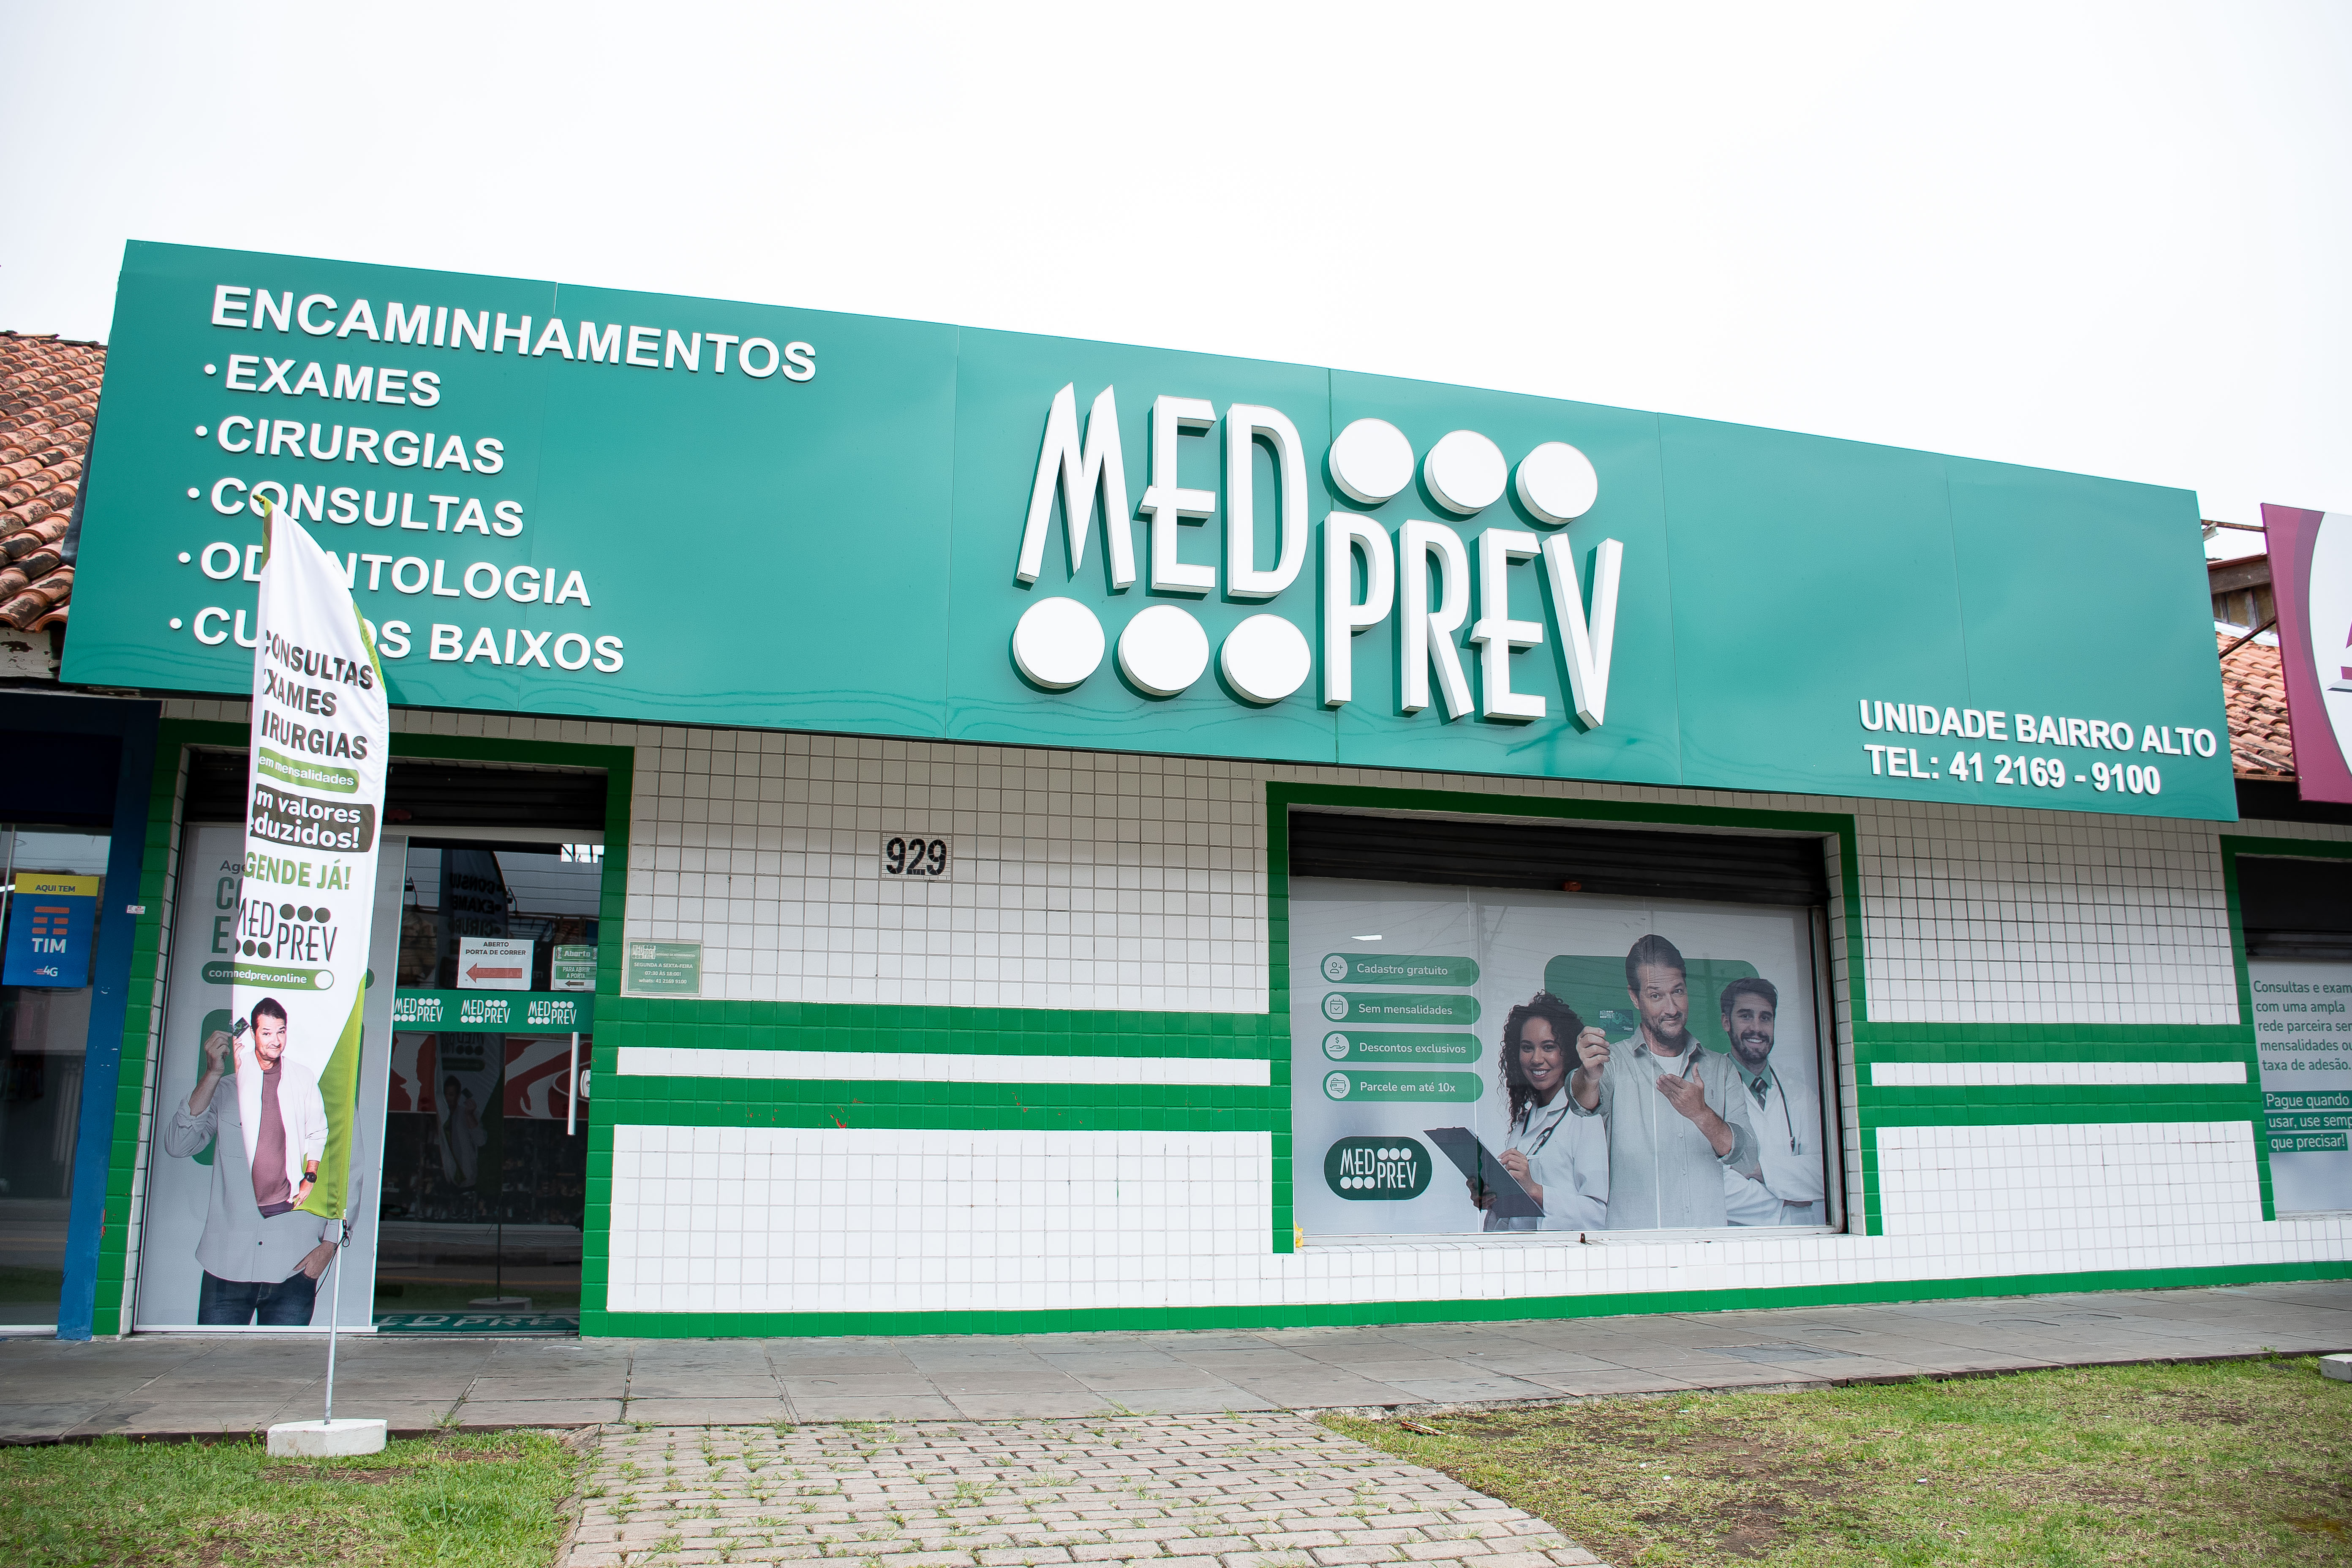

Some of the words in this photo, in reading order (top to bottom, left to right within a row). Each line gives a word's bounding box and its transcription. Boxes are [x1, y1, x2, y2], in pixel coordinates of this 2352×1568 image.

[212, 284, 818, 382] ENCAMINHAMENTOS
[225, 354, 441, 407] EXAMES
[217, 416, 505, 474] CIRURGIAS
[1016, 382, 1309, 598] MED
[211, 477, 524, 537] CONSULTAS
[200, 542, 592, 607] ODNTOLOGIA
[1324, 512, 1623, 730] PREV
[193, 607, 412, 661] CUS
[429, 622, 624, 674] BAIXOS
[263, 669, 338, 716] XAMES
[261, 710, 368, 760] IRURGIAS
[1859, 700, 2008, 741] UNIDADE
[2014, 714, 2134, 751] BAIRRO
[2140, 725, 2217, 757] ALTO
[275, 761, 354, 786] mensalidades
[1863, 745, 1939, 780] TEL:
[1948, 751, 1984, 783] 41
[1995, 755, 2065, 789] 2169
[2091, 762, 2161, 795] 9100
[278, 798, 361, 824] valores
[250, 811, 360, 849] duzidos!
[886, 837, 947, 876] 929
[316, 858, 351, 890] JÁ!
[32, 938, 67, 953] TIM
[276, 923, 338, 962] PREV
[44, 966, 58, 977] 4G
[1356, 963, 1404, 975] Cadastro
[1407, 965, 1448, 976] gratuito
[2254, 980, 2310, 994] Consultas
[2313, 984, 2320, 993] e
[394, 997, 416, 1014] MED
[417, 1006, 444, 1022] PREV
[461, 999, 485, 1015] MED
[484, 1007, 511, 1024] PREV
[528, 1000, 550, 1017] MED
[1358, 1004, 1381, 1014] Sem
[1384, 1004, 1453, 1015] mensalidades
[2256, 1002, 2280, 1013] com
[2283, 1003, 2307, 1012] uma
[2311, 1000, 2345, 1015] ampla
[551, 1008, 577, 1025] PREV
[2258, 1019, 2284, 1032] rede
[2287, 1019, 2332, 1034] parceira
[1359, 1043, 1413, 1053] Descontos
[1415, 1043, 1467, 1054] exclusivos
[2261, 1039, 2338, 1051] mensalidades
[2262, 1059, 2287, 1071] taxa
[2291, 1059, 2305, 1071] de
[2308, 1057, 2352, 1071] adesão.
[1360, 1082, 1398, 1092] Parcele
[1419, 1082, 1435, 1092] até
[1438, 1083, 1456, 1092] 10x
[2267, 1094, 2303, 1110] Pague
[2306, 1092, 2349, 1109] quando
[2268, 1116, 2297, 1129] usar,
[2300, 1116, 2321, 1127] use
[2271, 1137, 2293, 1151] que
[2296, 1133, 2346, 1150] precisar!
[1340, 1148, 1375, 1175] MED
[1377, 1161, 1417, 1189] PREV
